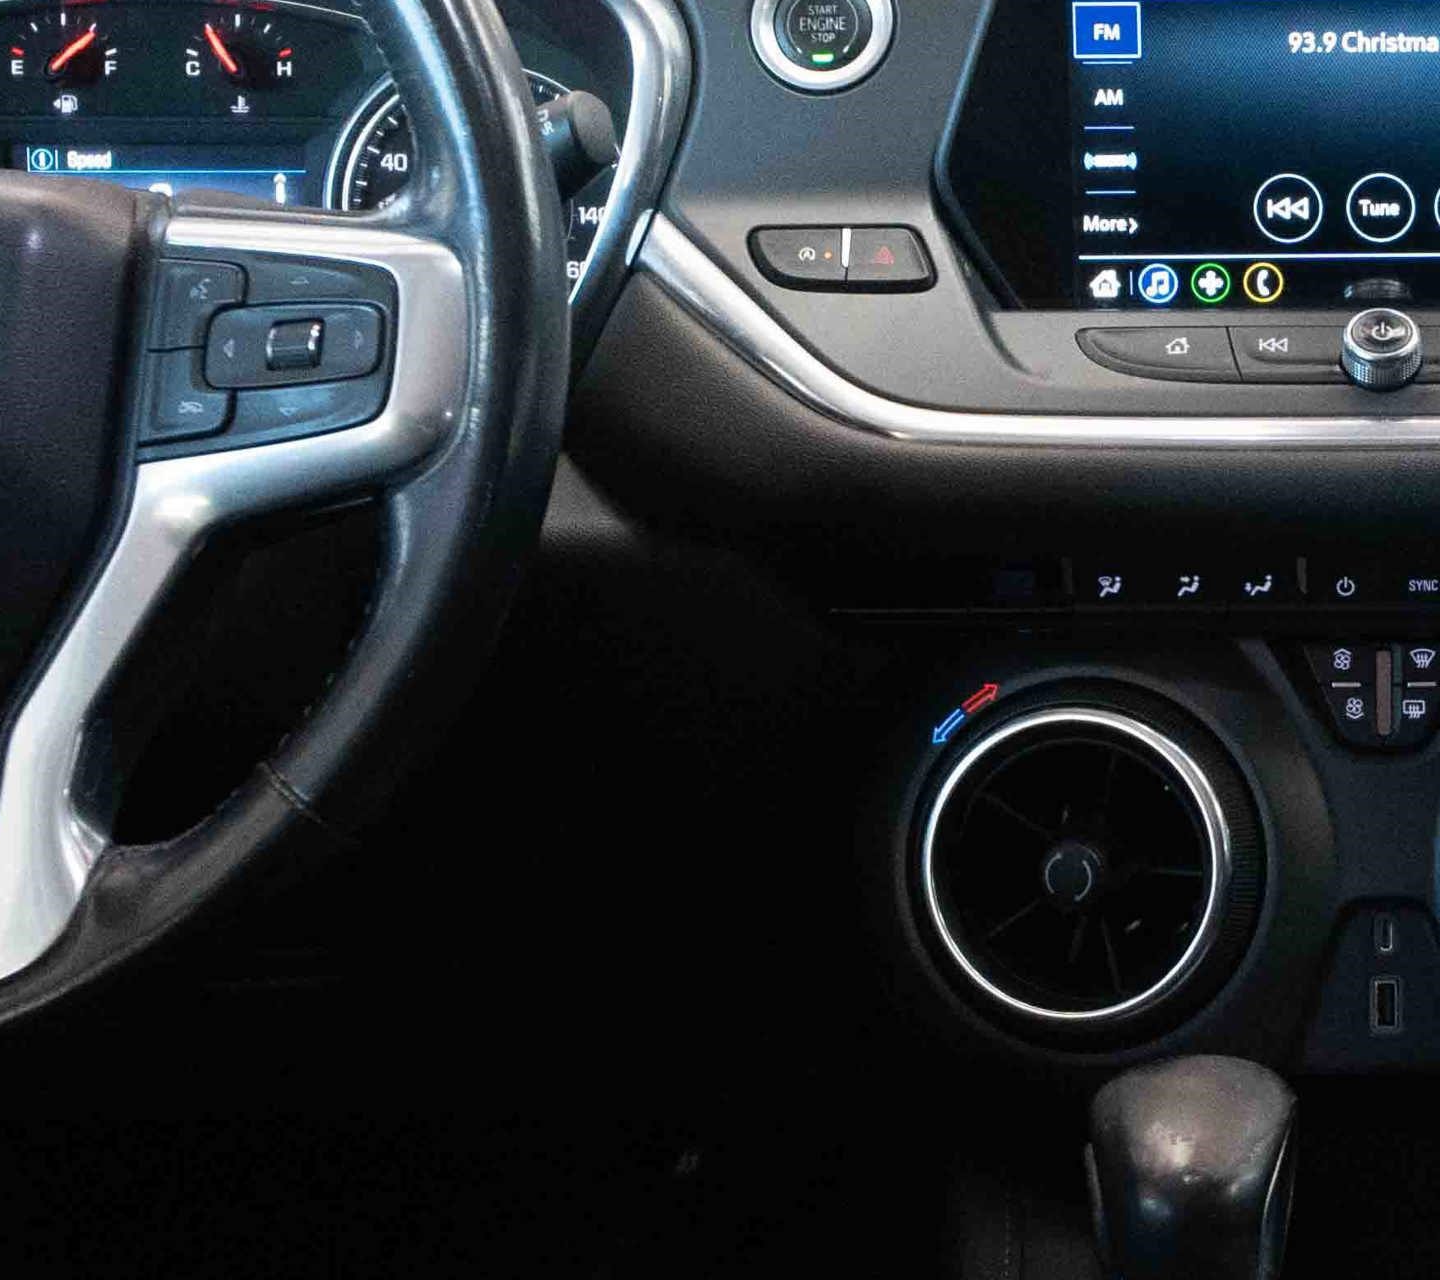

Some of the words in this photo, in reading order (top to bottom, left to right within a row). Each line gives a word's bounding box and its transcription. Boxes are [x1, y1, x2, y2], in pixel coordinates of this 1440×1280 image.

[808, 5, 837, 16] START
[799, 16, 847, 32] ENGINE
[1093, 23, 1120, 41] FM
[811, 32, 836, 43] STOP
[1288, 31, 1337, 53] 93.9
[1341, 30, 1440, 53] Christma
[11, 59, 24, 75] E
[104, 60, 117, 75] F
[185, 60, 201, 76] C
[276, 60, 292, 77] H
[1094, 88, 1123, 106] AM
[380, 153, 408, 172] 40
[1359, 199, 1400, 217] Tune
[1083, 215, 1127, 233] More
[1408, 578, 1439, 593] SYNC
